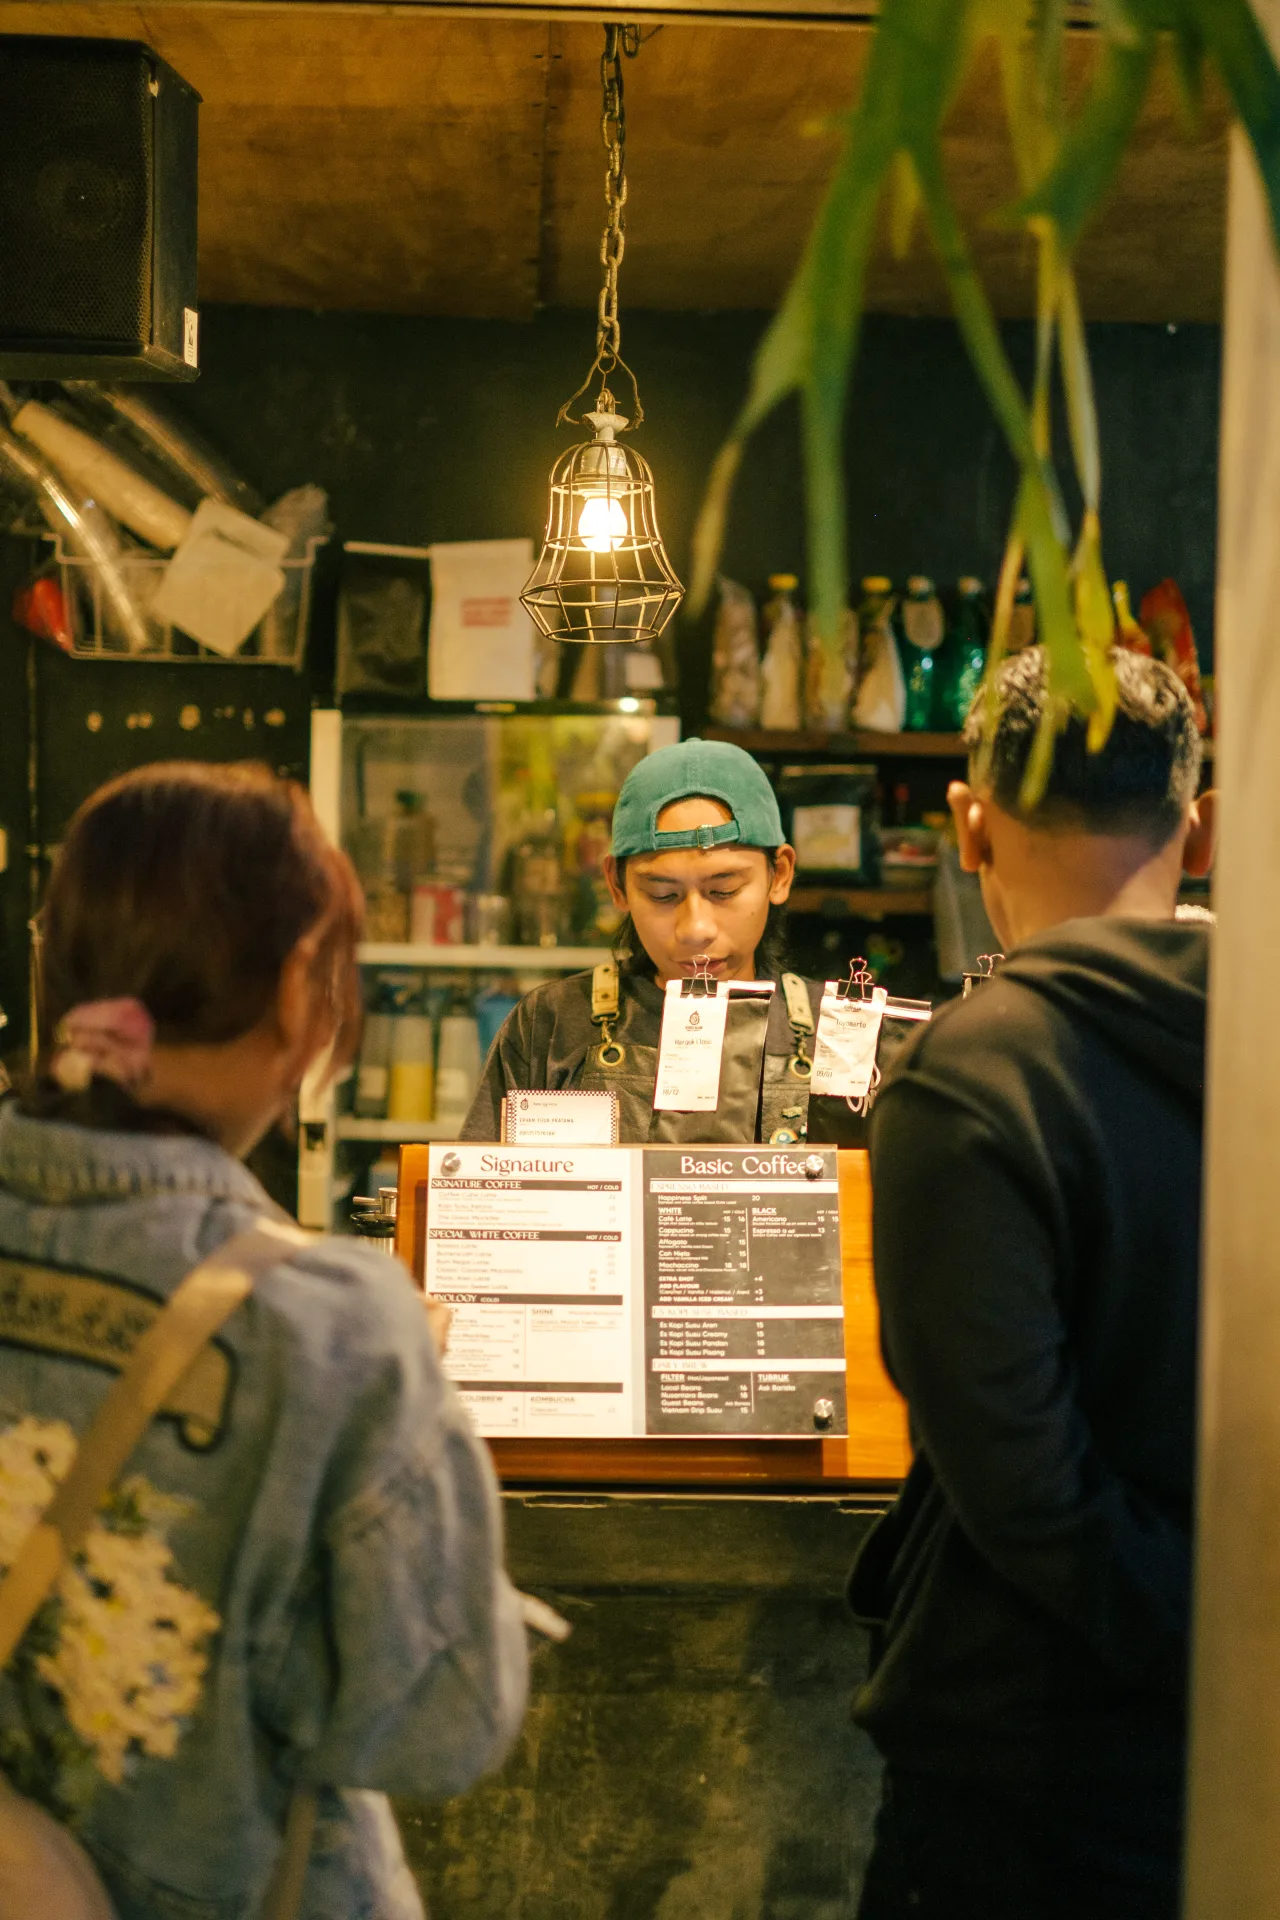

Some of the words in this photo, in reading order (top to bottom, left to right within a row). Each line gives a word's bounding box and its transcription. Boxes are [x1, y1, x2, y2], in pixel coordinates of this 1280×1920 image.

[480, 1154, 574, 1176] Signature
[681, 1156, 734, 1174] Basic
[742, 1155, 807, 1174] Coffee
[432, 1180, 482, 1188] SIGNATURE
[485, 1181, 522, 1189] COFFEE
[430, 1230, 466, 1239] SPECIAL
[470, 1230, 500, 1239] WHITE
[503, 1232, 540, 1240] COFFEE
